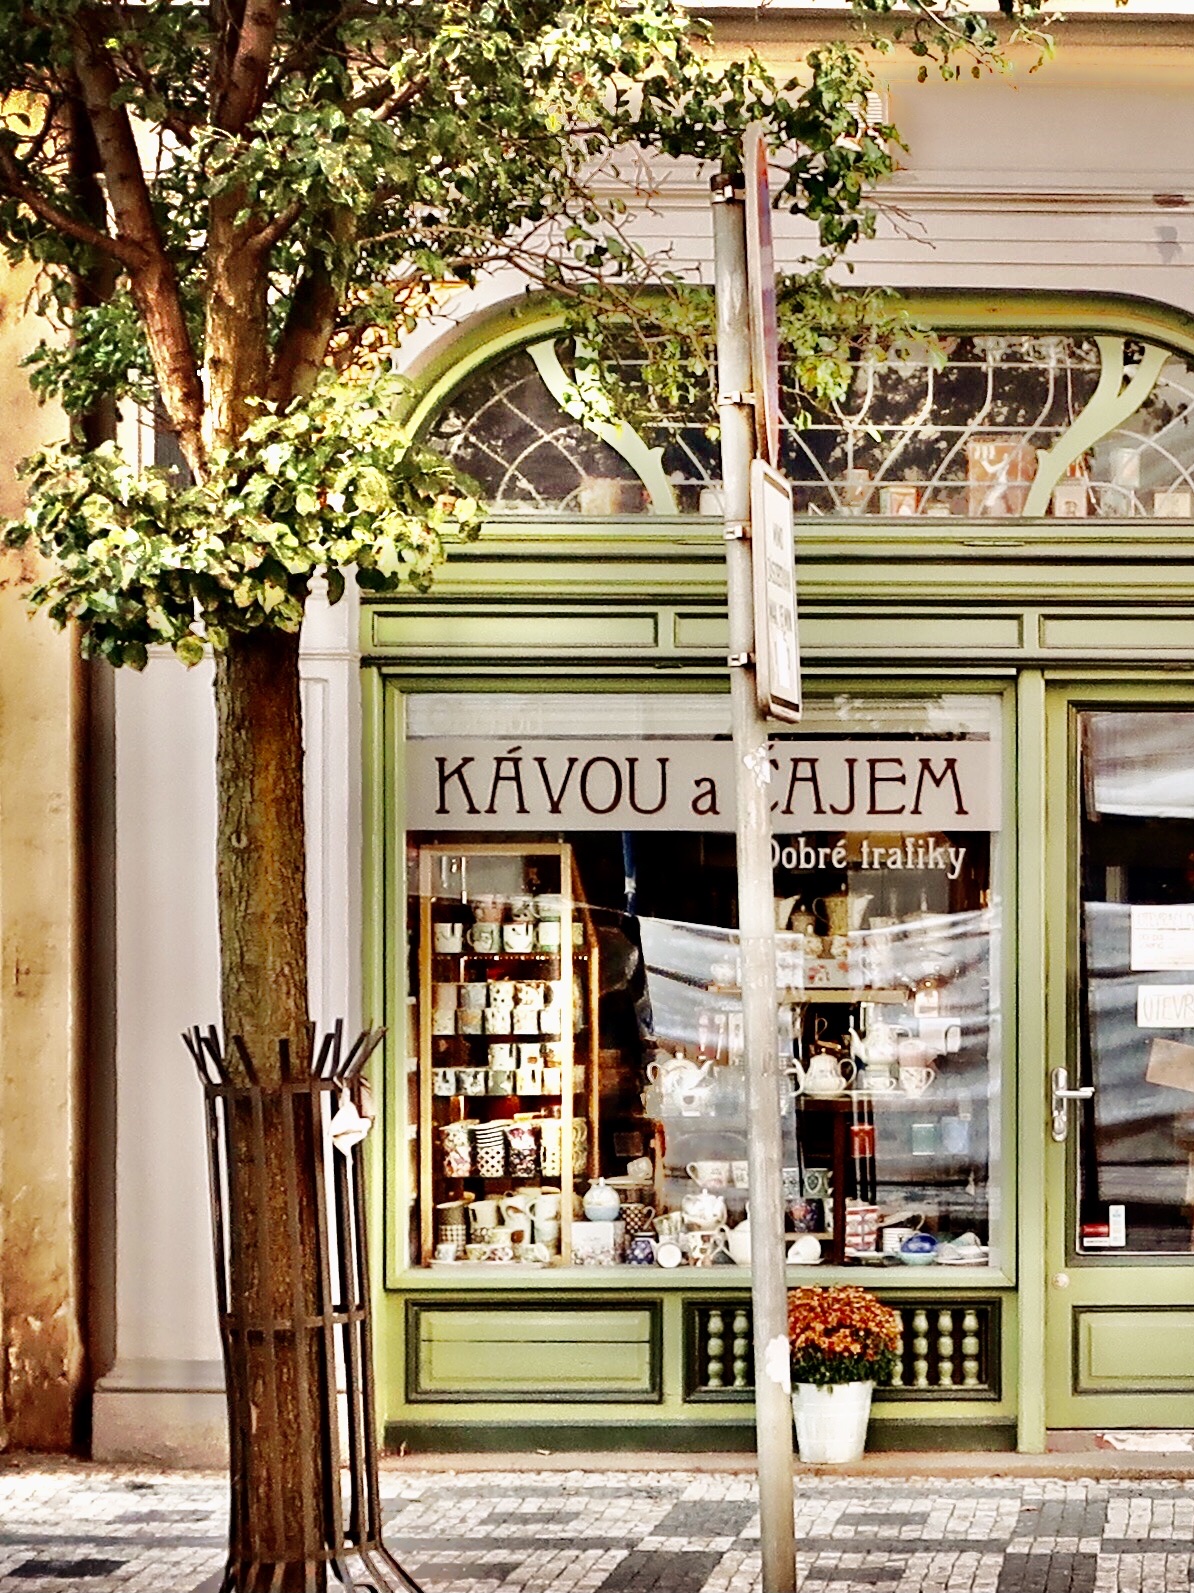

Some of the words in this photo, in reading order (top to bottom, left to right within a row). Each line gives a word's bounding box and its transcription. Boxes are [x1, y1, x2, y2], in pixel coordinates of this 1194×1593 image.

[434, 745, 670, 815] KÁVOU
[691, 777, 719, 815] a
[767, 744, 969, 815] AJEM
